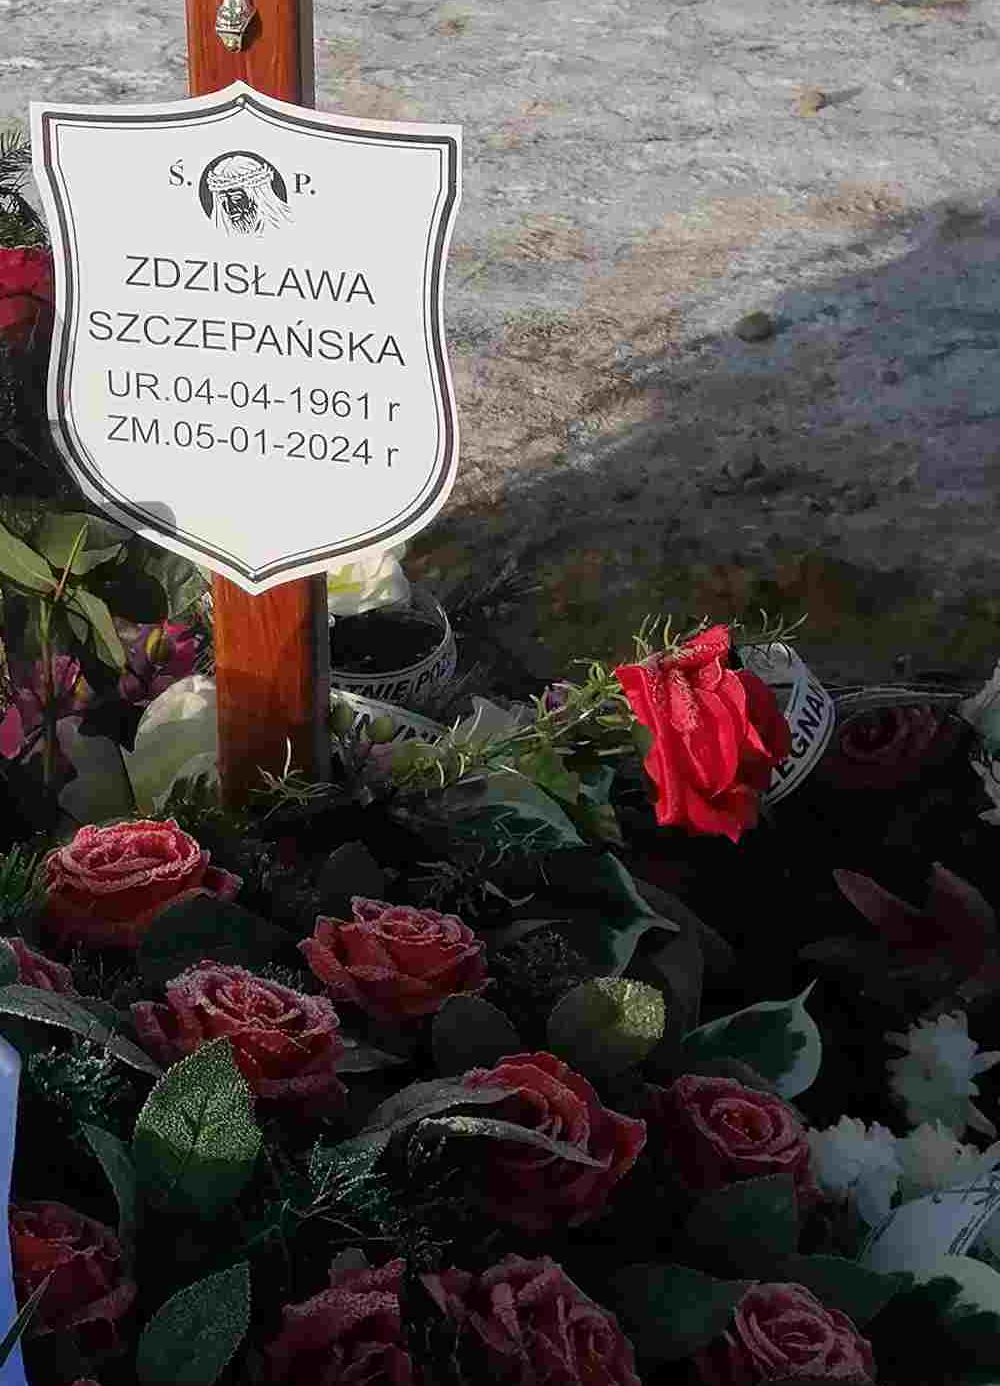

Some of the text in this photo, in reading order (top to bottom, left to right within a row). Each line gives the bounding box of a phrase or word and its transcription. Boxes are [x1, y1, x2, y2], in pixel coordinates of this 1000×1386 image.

[168, 158, 317, 195] Ś. P.
[125, 255, 376, 305] ZDZISŁAWA
[88, 310, 406, 367] SZCZEPAŃSKA
[107, 369, 401, 422] UR.04-04-1961 r
[107, 414, 400, 468] ZM.05-01-2024 r
